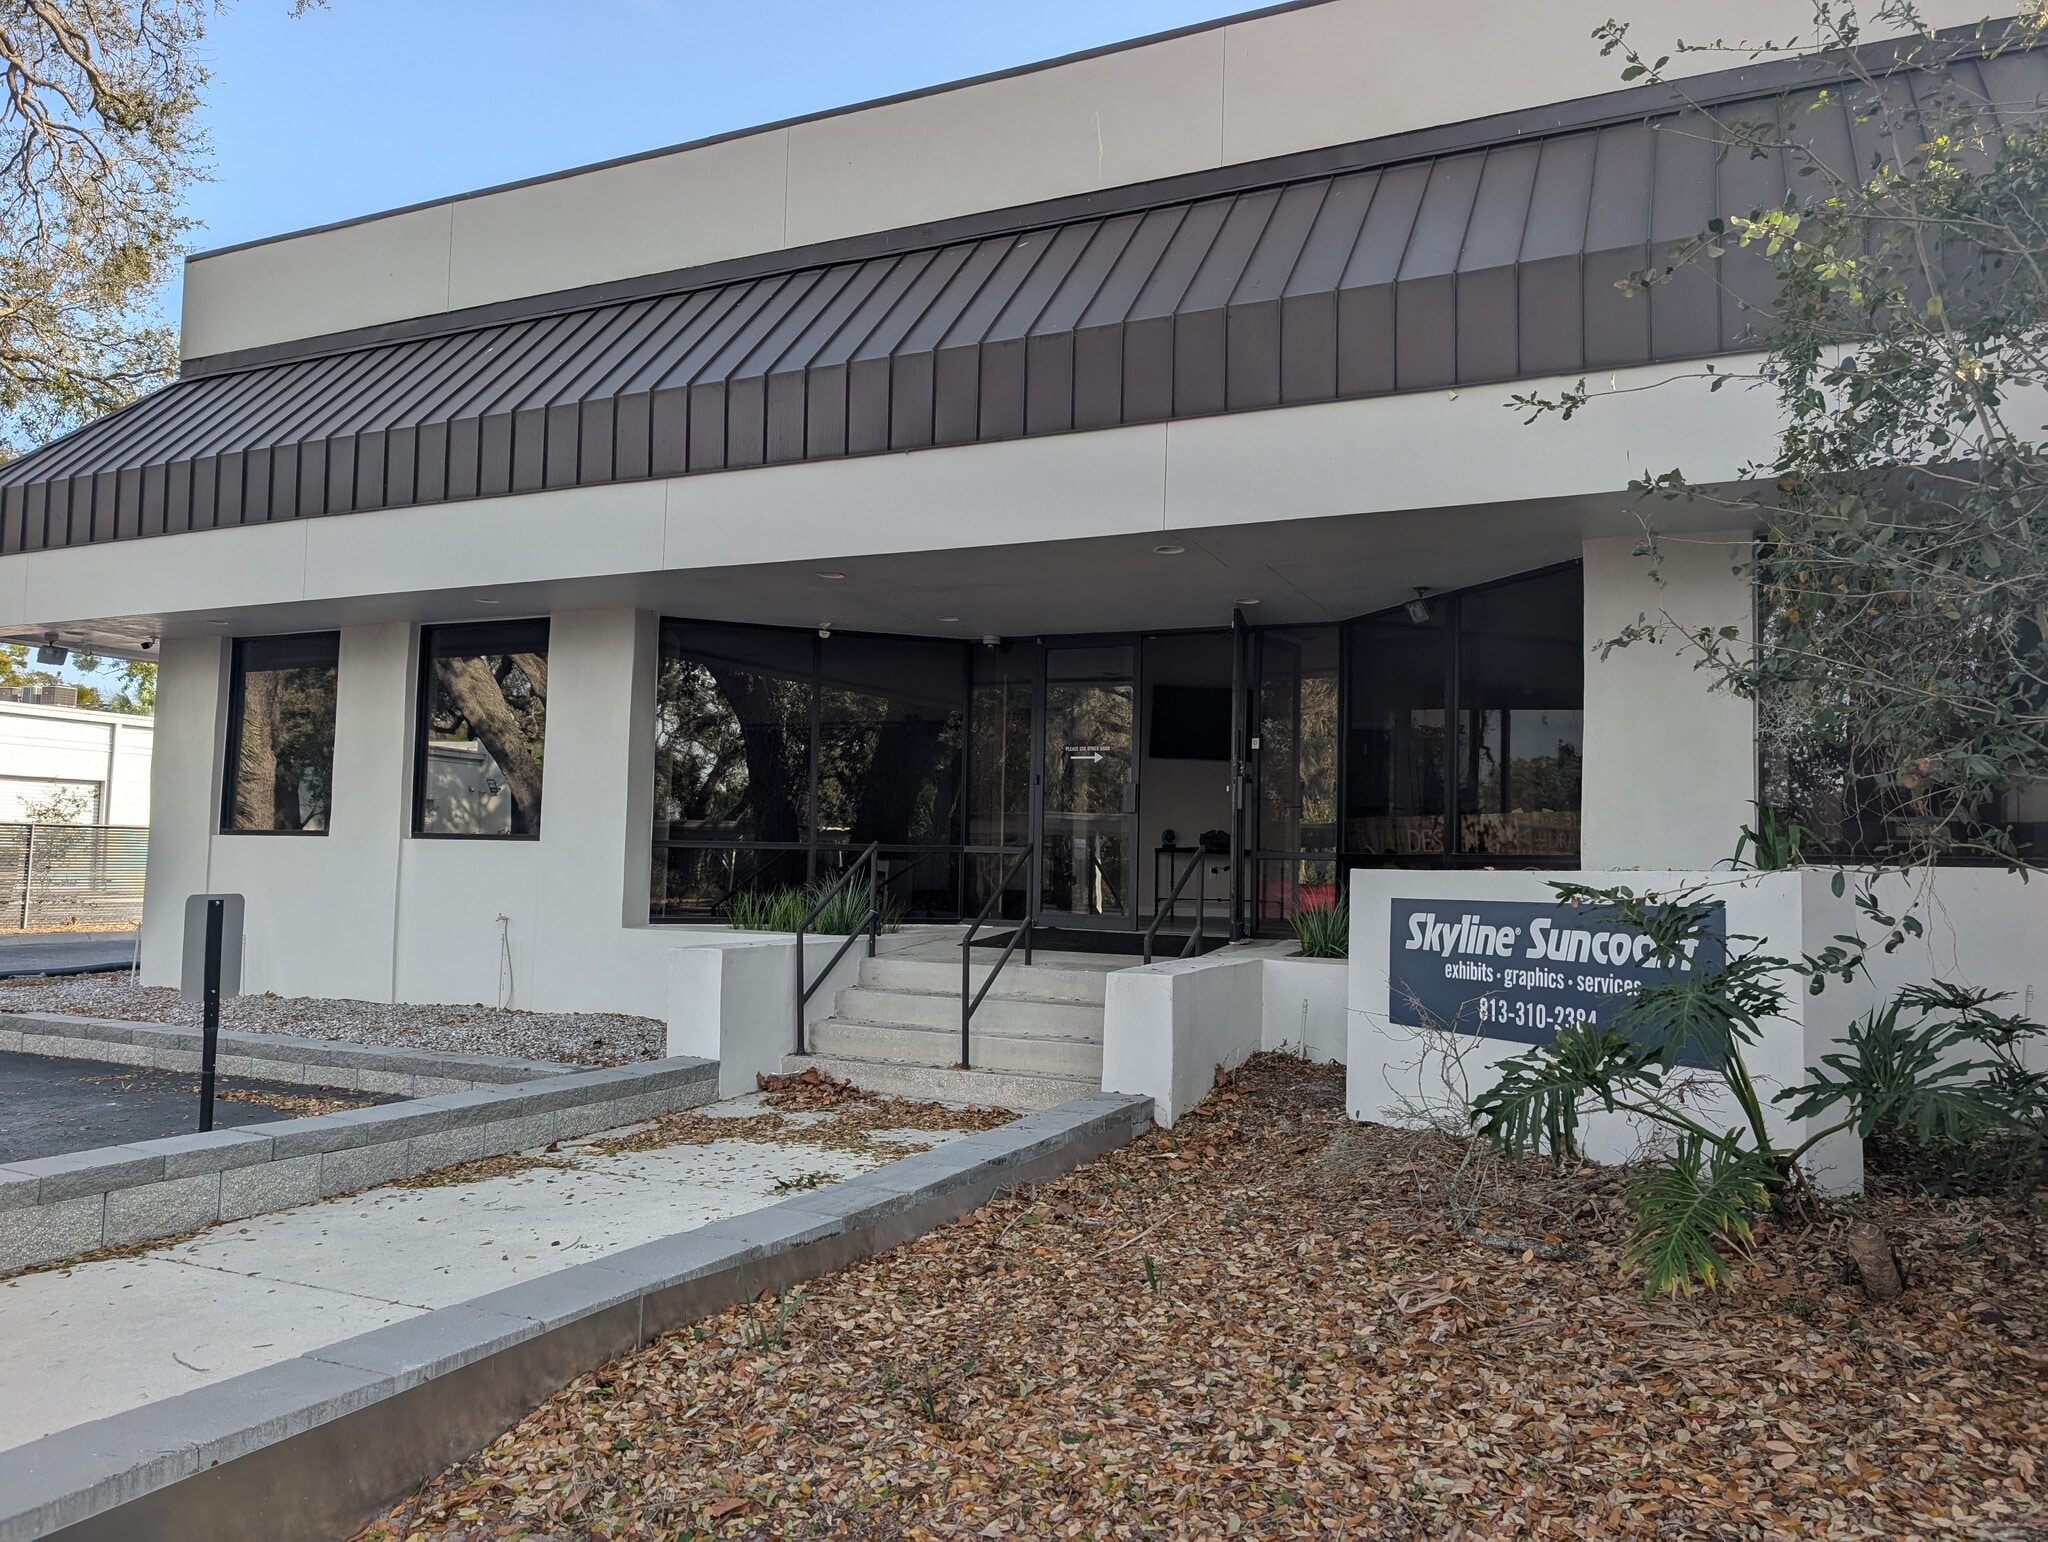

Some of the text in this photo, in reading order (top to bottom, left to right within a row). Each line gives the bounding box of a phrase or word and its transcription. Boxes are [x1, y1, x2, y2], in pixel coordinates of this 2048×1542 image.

[1405, 912, 1516, 957] Skyline
[1444, 960, 1643, 997] exhibits graphics services
